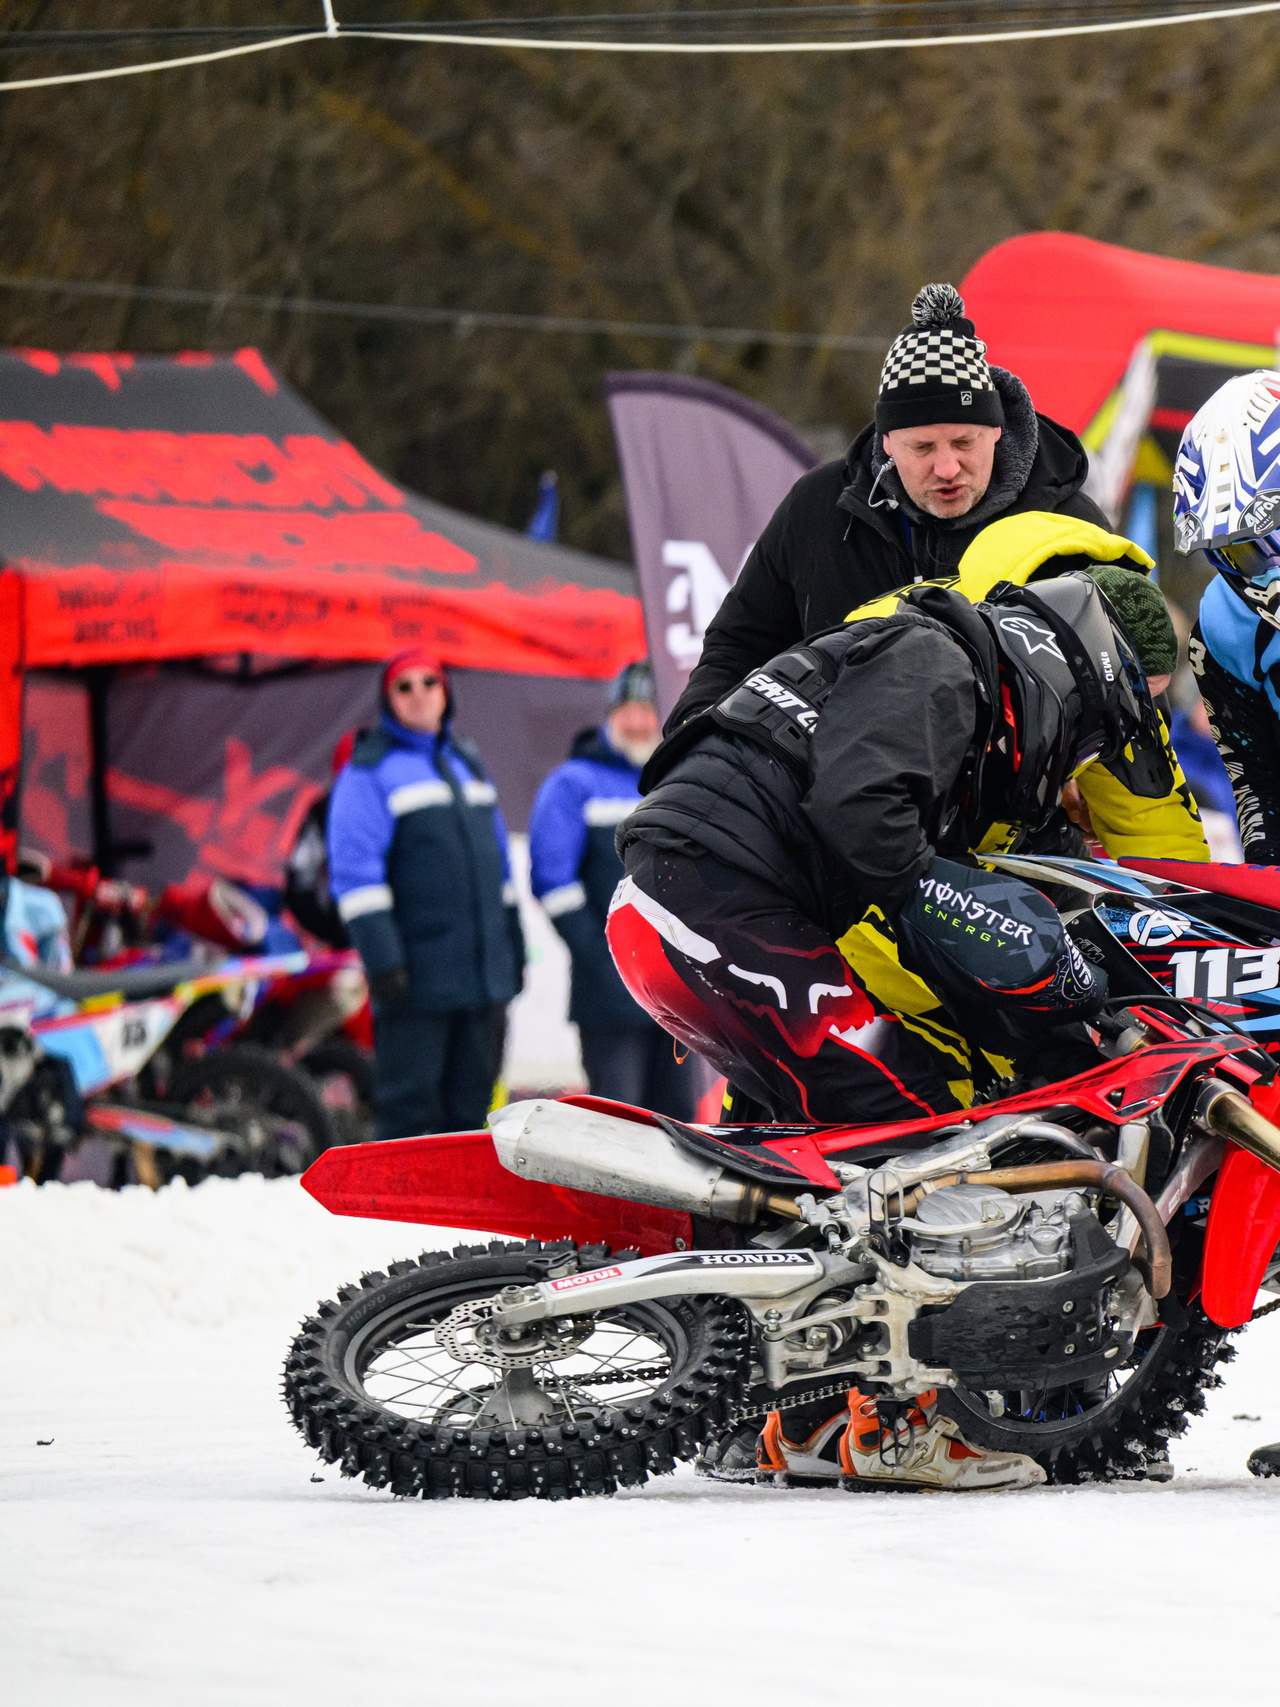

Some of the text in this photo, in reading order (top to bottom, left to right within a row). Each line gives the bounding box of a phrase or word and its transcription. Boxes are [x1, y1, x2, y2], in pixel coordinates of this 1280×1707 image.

[924, 903, 1007, 948] ENERGY
[700, 1251, 808, 1266] HONDA
[556, 1268, 620, 1290] MOTUL
